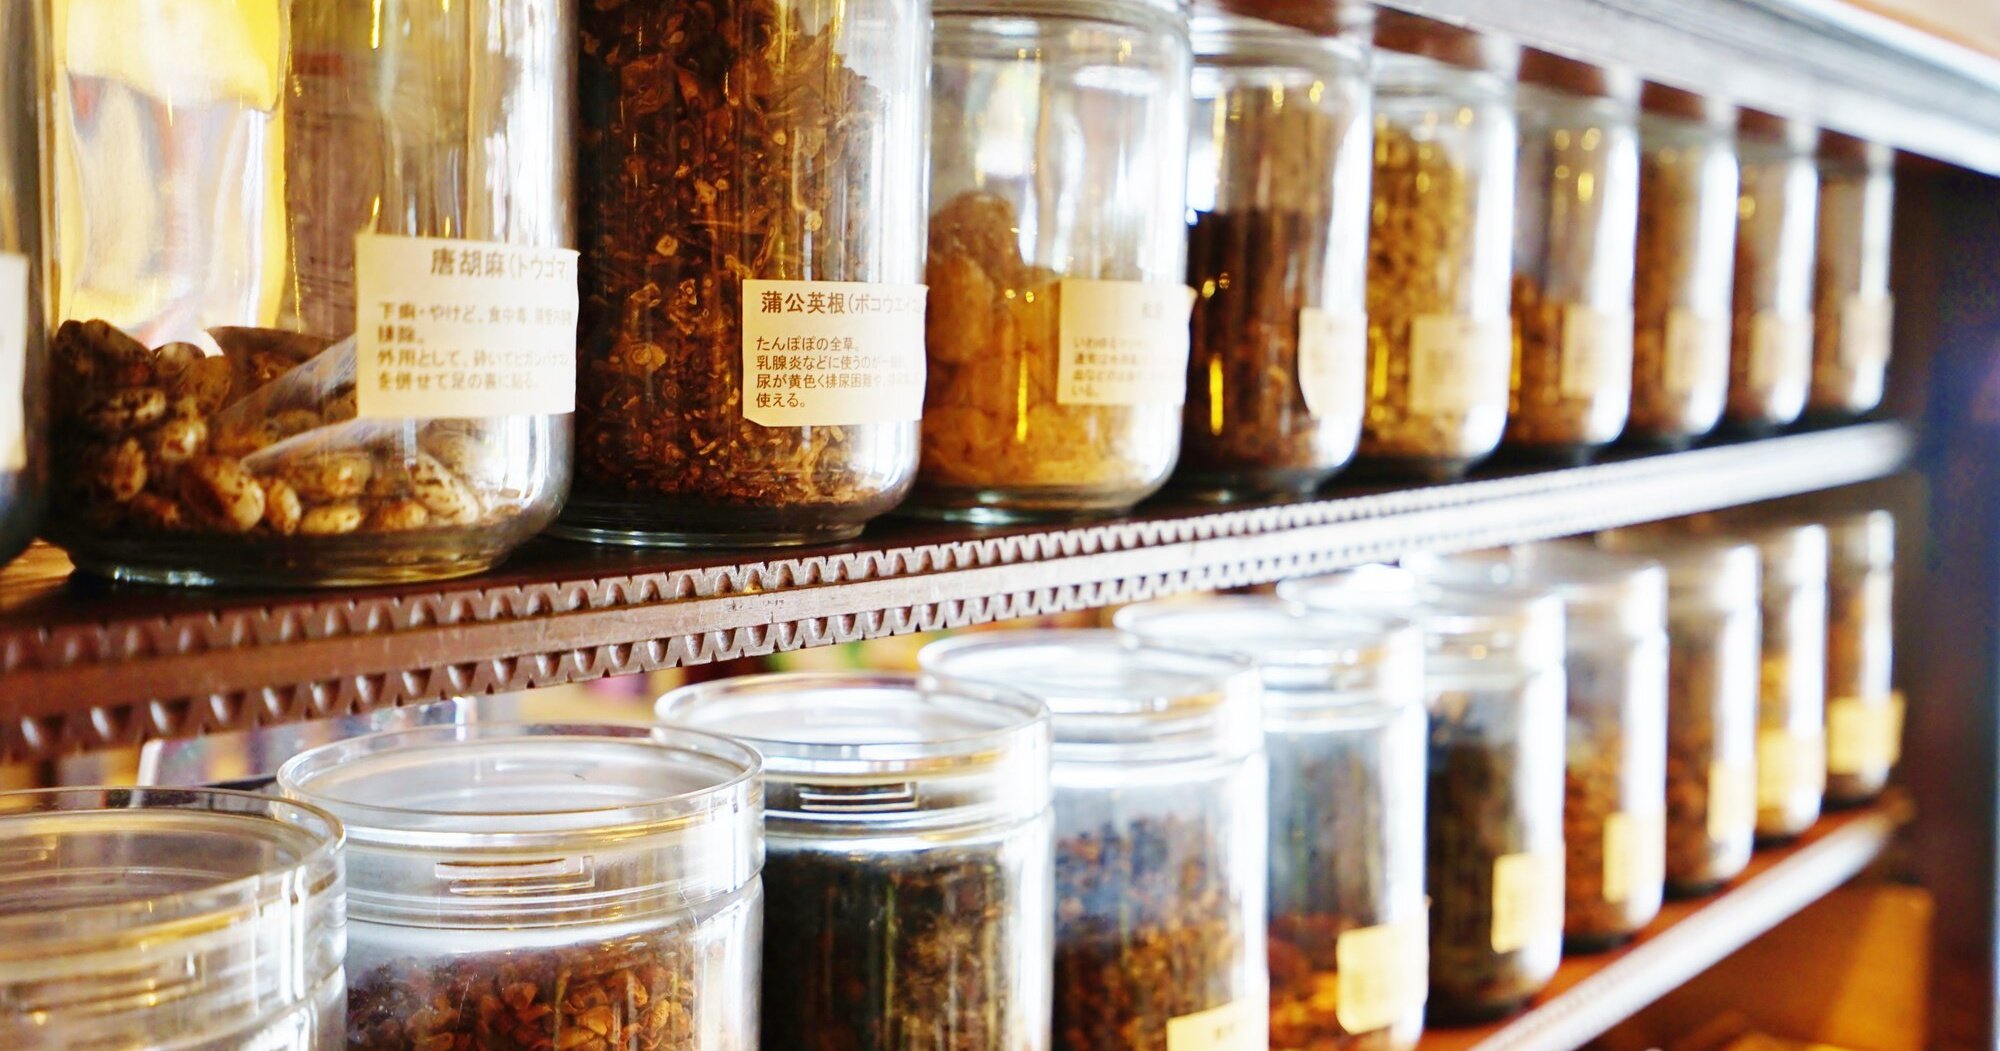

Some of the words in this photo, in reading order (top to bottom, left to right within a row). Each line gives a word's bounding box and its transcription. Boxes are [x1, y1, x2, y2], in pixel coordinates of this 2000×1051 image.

[756, 335, 860, 351] たんぽぽの全草。
[756, 392, 806, 409] 使える。
